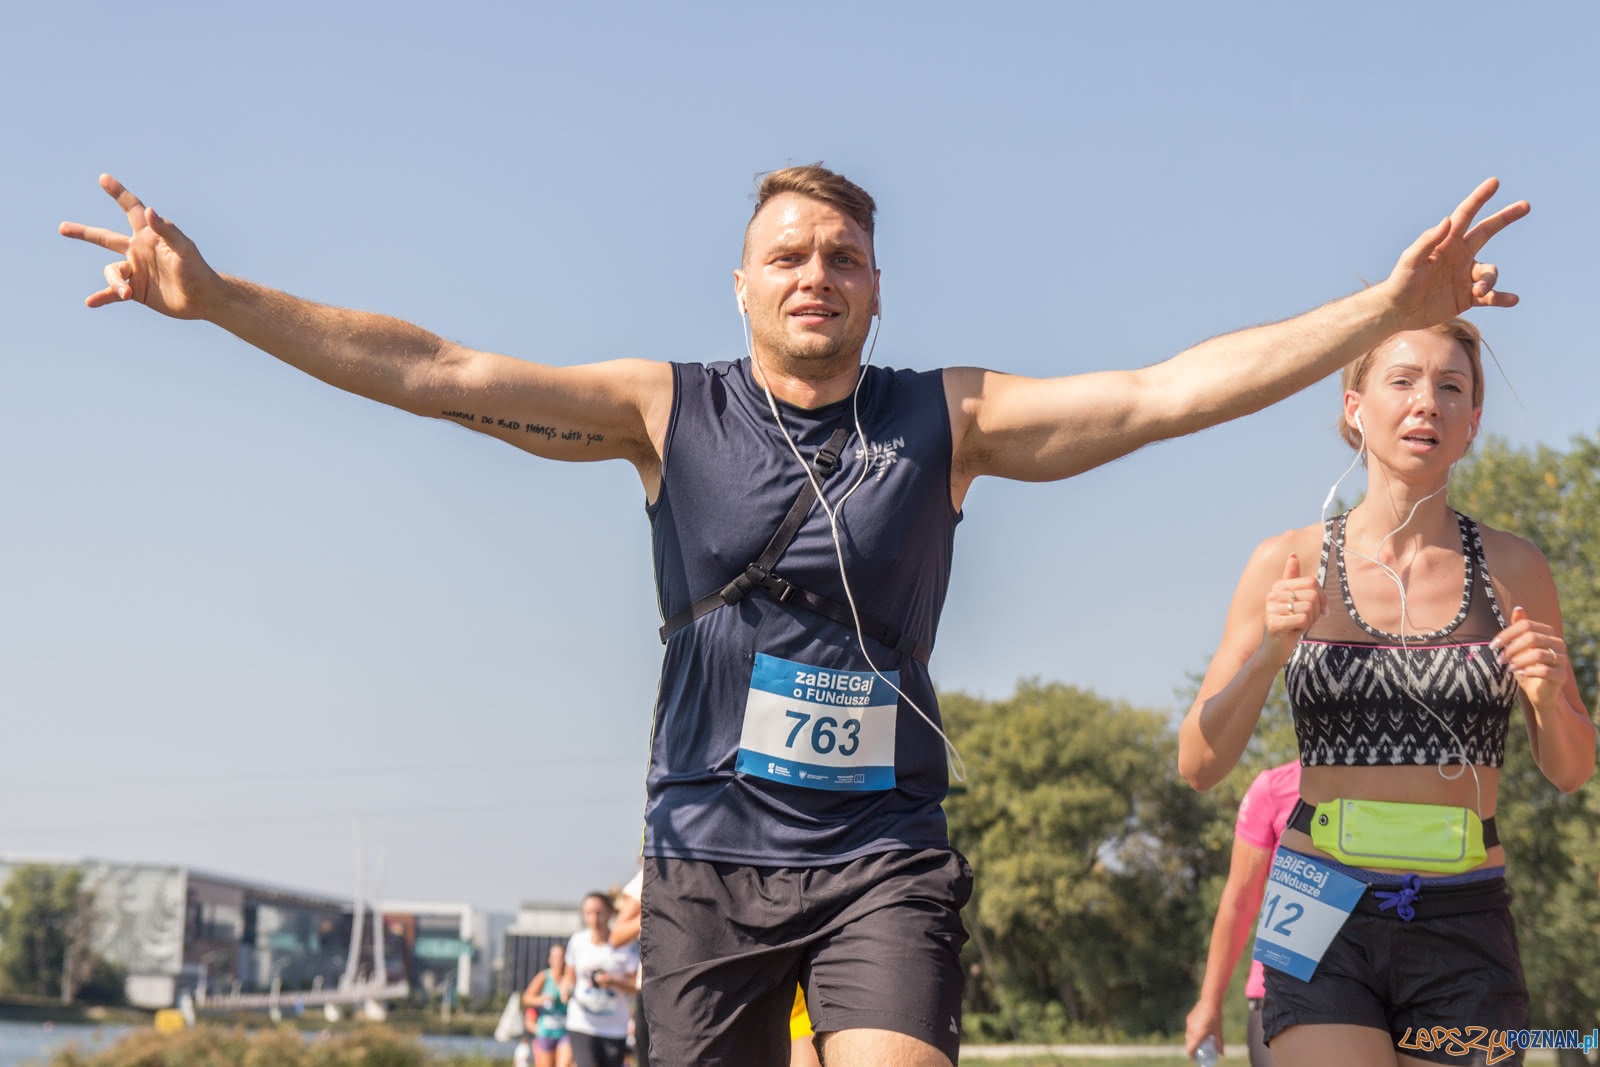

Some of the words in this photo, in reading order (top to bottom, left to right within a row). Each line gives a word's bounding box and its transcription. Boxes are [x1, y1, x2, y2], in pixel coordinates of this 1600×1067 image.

[793, 688, 802, 698] o
[806, 688, 870, 705] FUNdusze
[795, 671, 874, 695] zaBIEGaj
[785, 710, 861, 756] 763
[1260, 890, 1304, 937] 12
